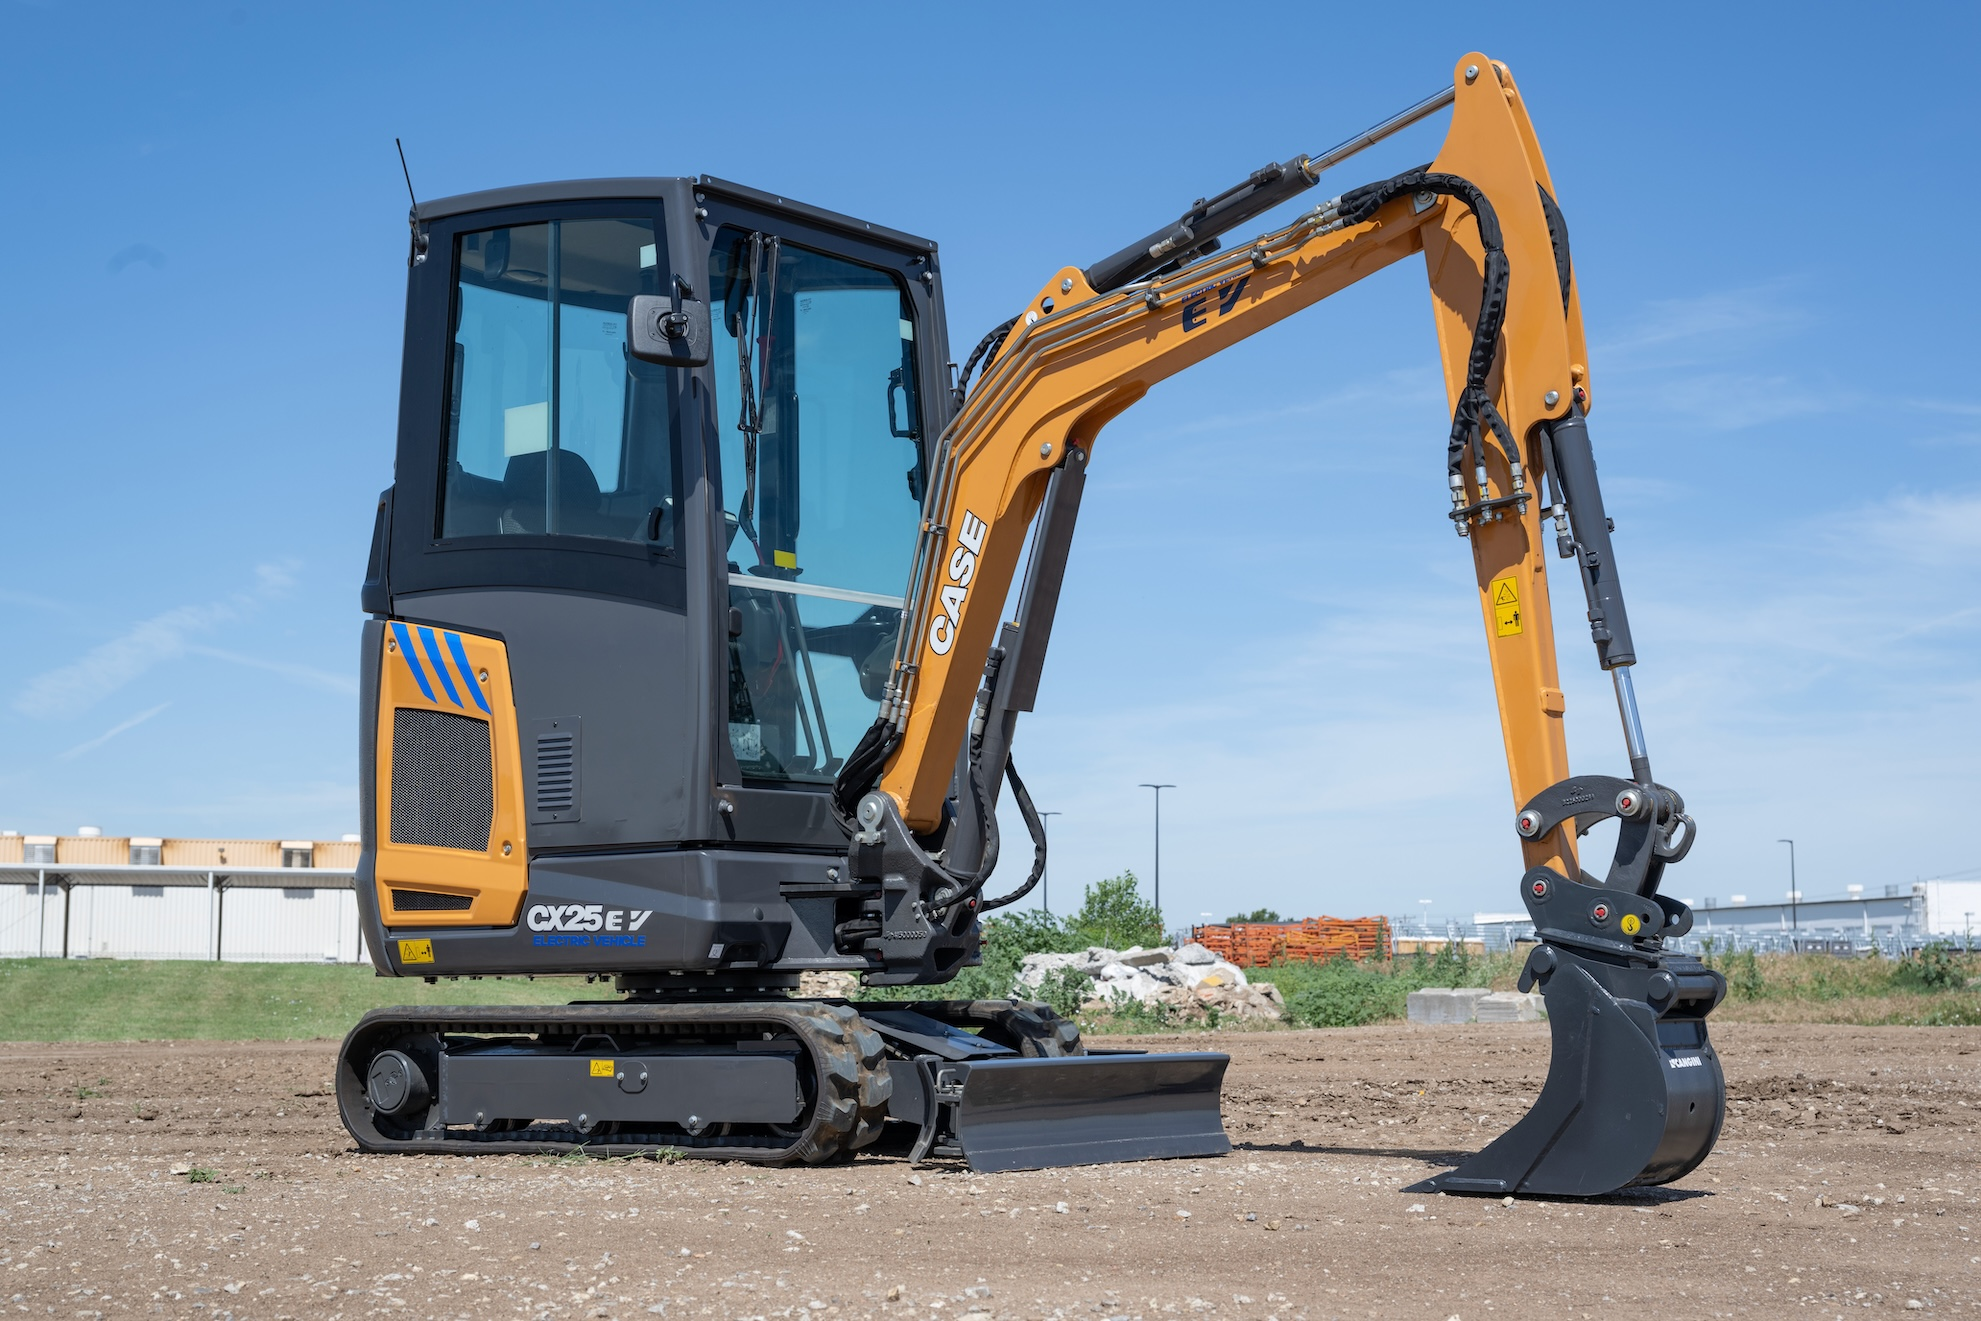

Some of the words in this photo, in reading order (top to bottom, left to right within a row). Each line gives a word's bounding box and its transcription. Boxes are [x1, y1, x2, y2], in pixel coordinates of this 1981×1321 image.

[1182, 275, 1251, 333] EV
[929, 509, 988, 656] CASE
[526, 903, 604, 932] CX25
[605, 910, 654, 931] EV
[533, 935, 591, 947] ELECTRIC
[593, 935, 646, 947] VEHICLE
